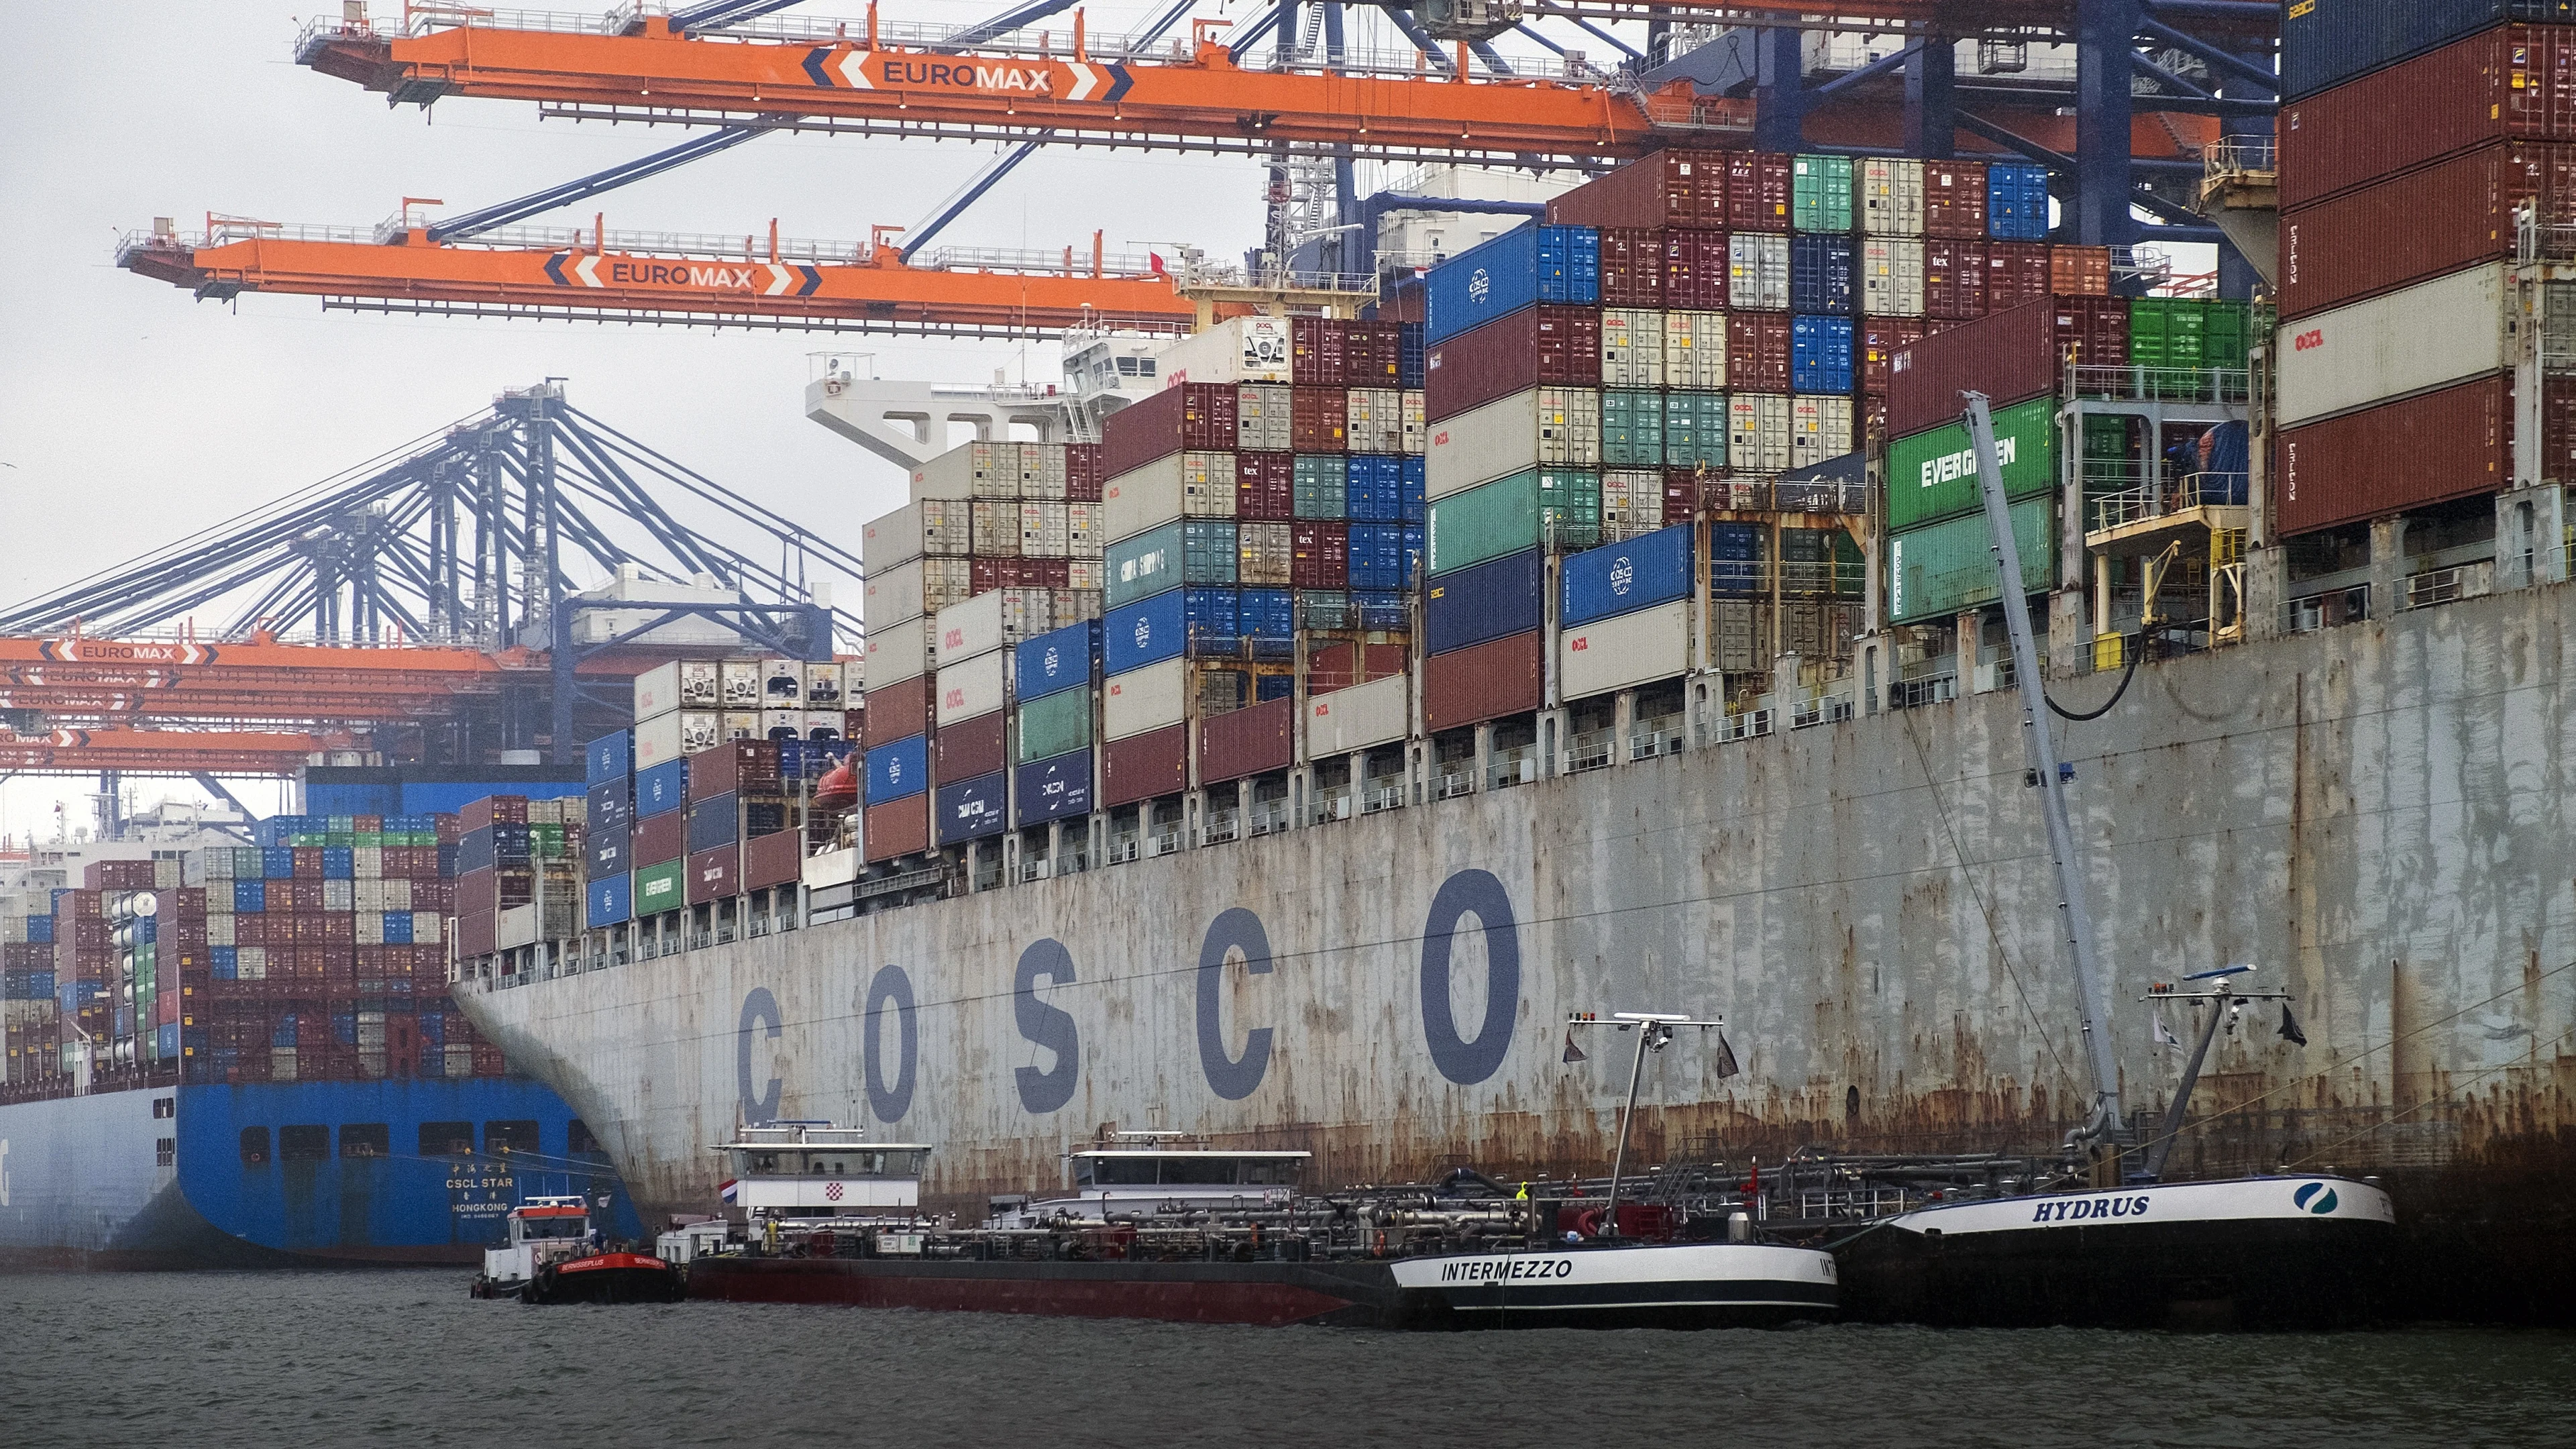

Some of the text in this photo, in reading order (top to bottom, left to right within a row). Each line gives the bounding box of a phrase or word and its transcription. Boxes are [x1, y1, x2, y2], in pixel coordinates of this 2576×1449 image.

[883, 61, 1051, 92] EUROMAX
[1933, 256, 1947, 266] tex
[613, 262, 755, 288] EUROMAX
[1469, 278, 1489, 293] COSCO
[1921, 437, 2016, 488] EVERGEN
[1244, 466, 1258, 476] tex
[1299, 535, 1313, 544] tex
[1611, 567, 1632, 581] COSCO
[83, 646, 176, 659] EUROMAX
[737, 869, 1520, 1126] COSCO
[446, 1179, 513, 1188] CSCL STAR
[452, 1203, 508, 1212] HONGKONG
[2033, 1196, 2149, 1222] HYDRUS
[561, 1259, 604, 1271] BERNISSEPLUS
[1442, 1260, 1572, 1281] INTERMEZZO
